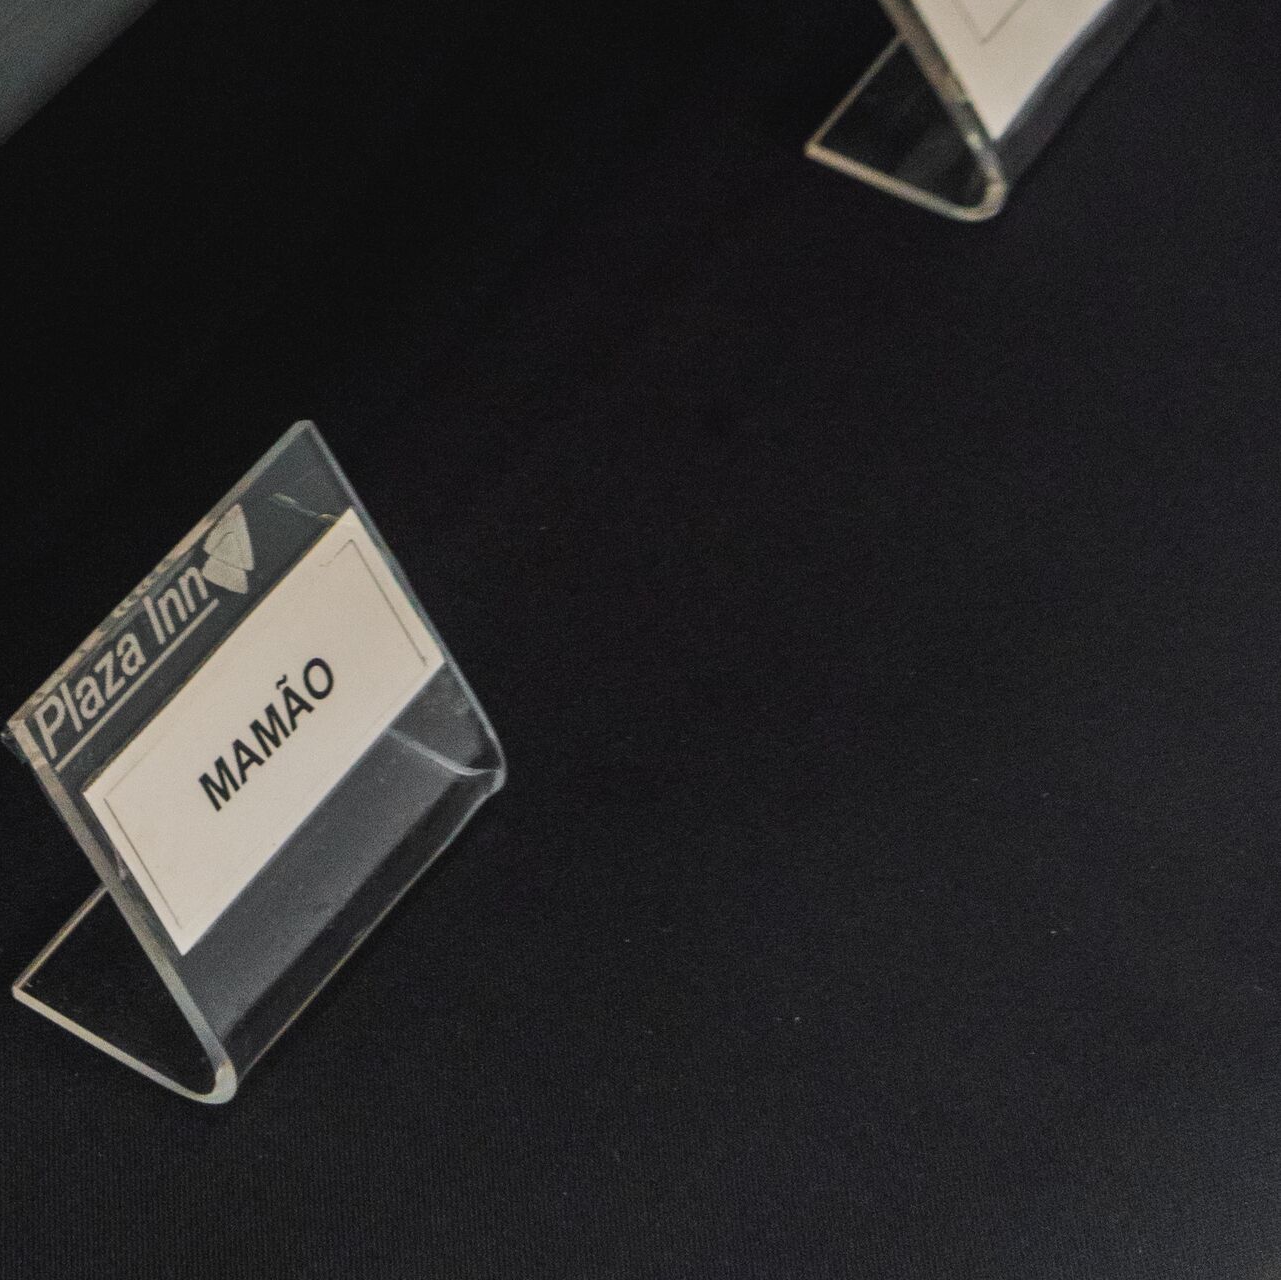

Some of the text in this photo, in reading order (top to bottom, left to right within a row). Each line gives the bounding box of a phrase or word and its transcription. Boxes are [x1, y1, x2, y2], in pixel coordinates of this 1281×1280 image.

[34, 566, 209, 759] Plaza Inn
[198, 657, 335, 812] MAMÃO
